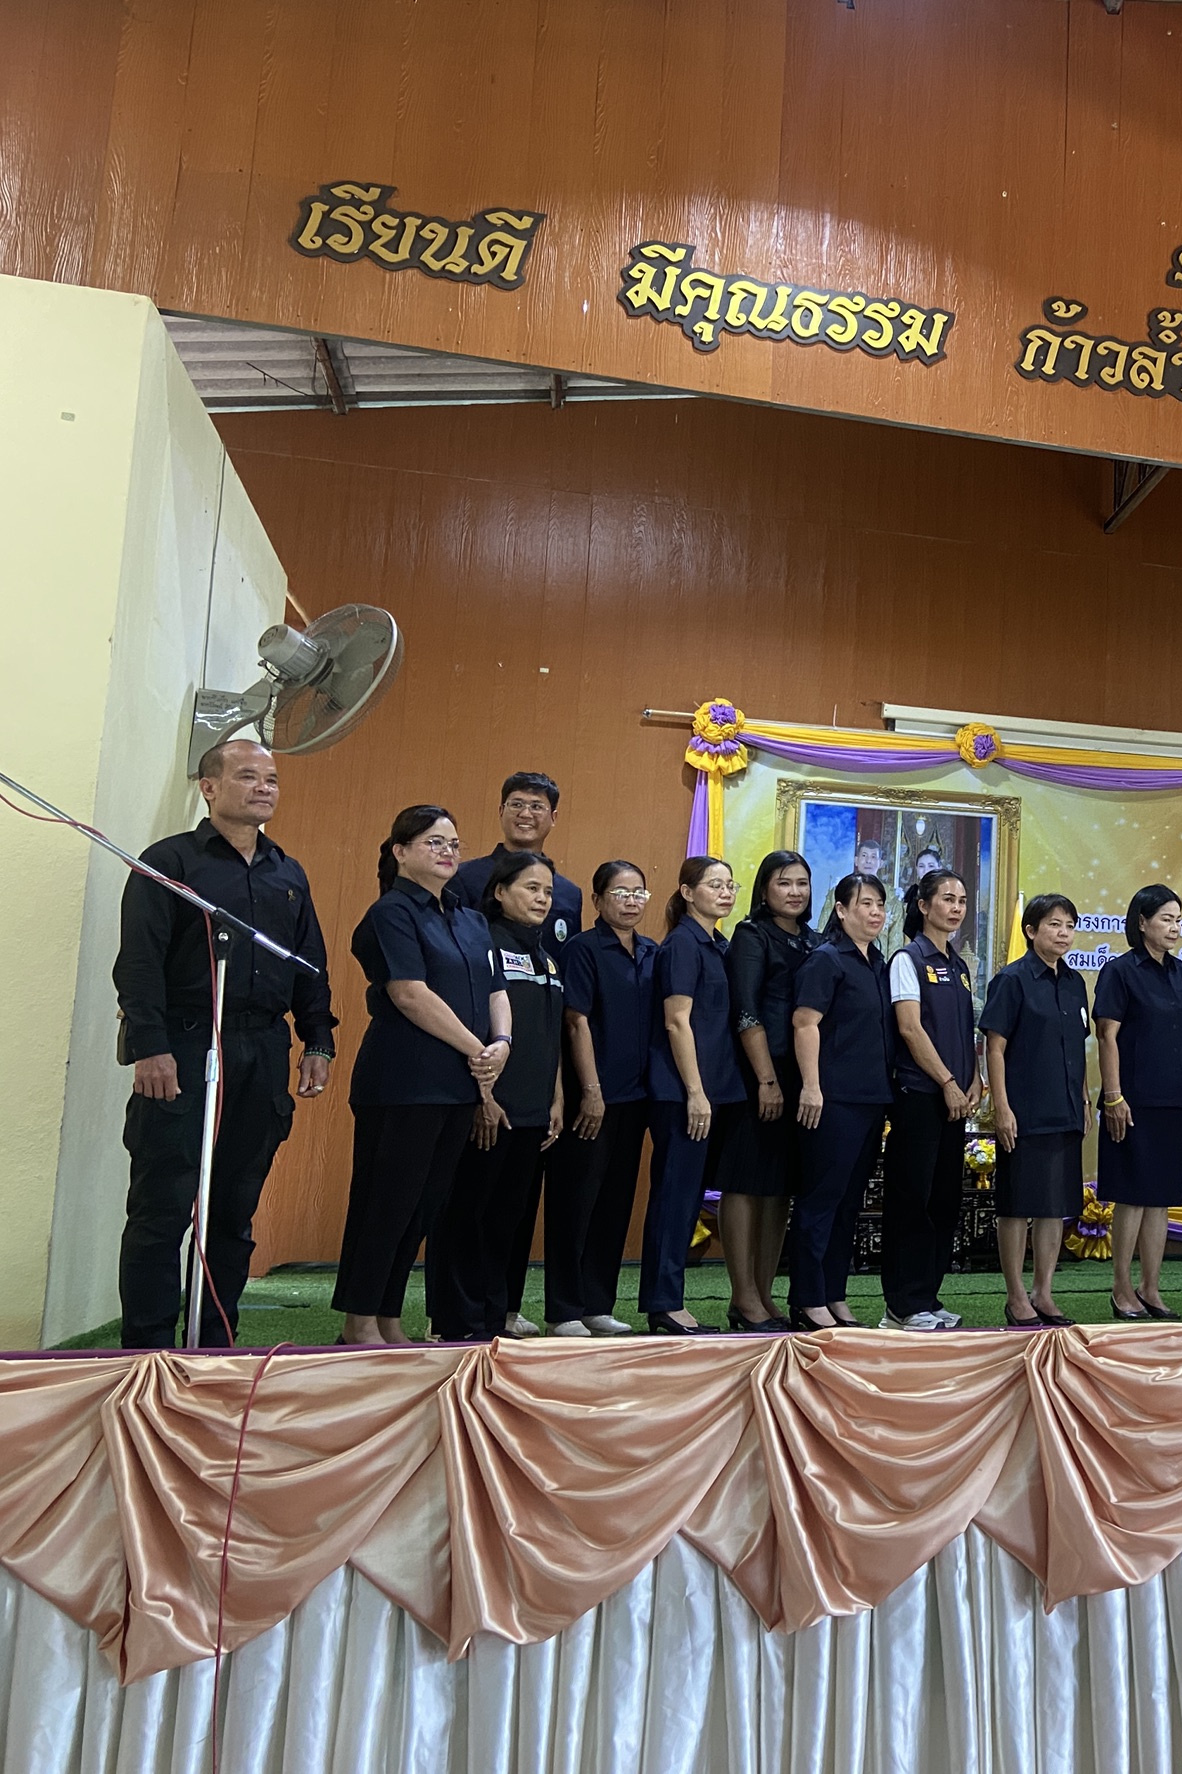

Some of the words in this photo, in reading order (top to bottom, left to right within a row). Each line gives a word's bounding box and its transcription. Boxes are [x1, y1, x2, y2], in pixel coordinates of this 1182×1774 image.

[298, 183, 531, 281] เรียนดี
[625, 244, 950, 356] มีคุณธรรม
[1068, 945, 1117, 967] สมเด็
